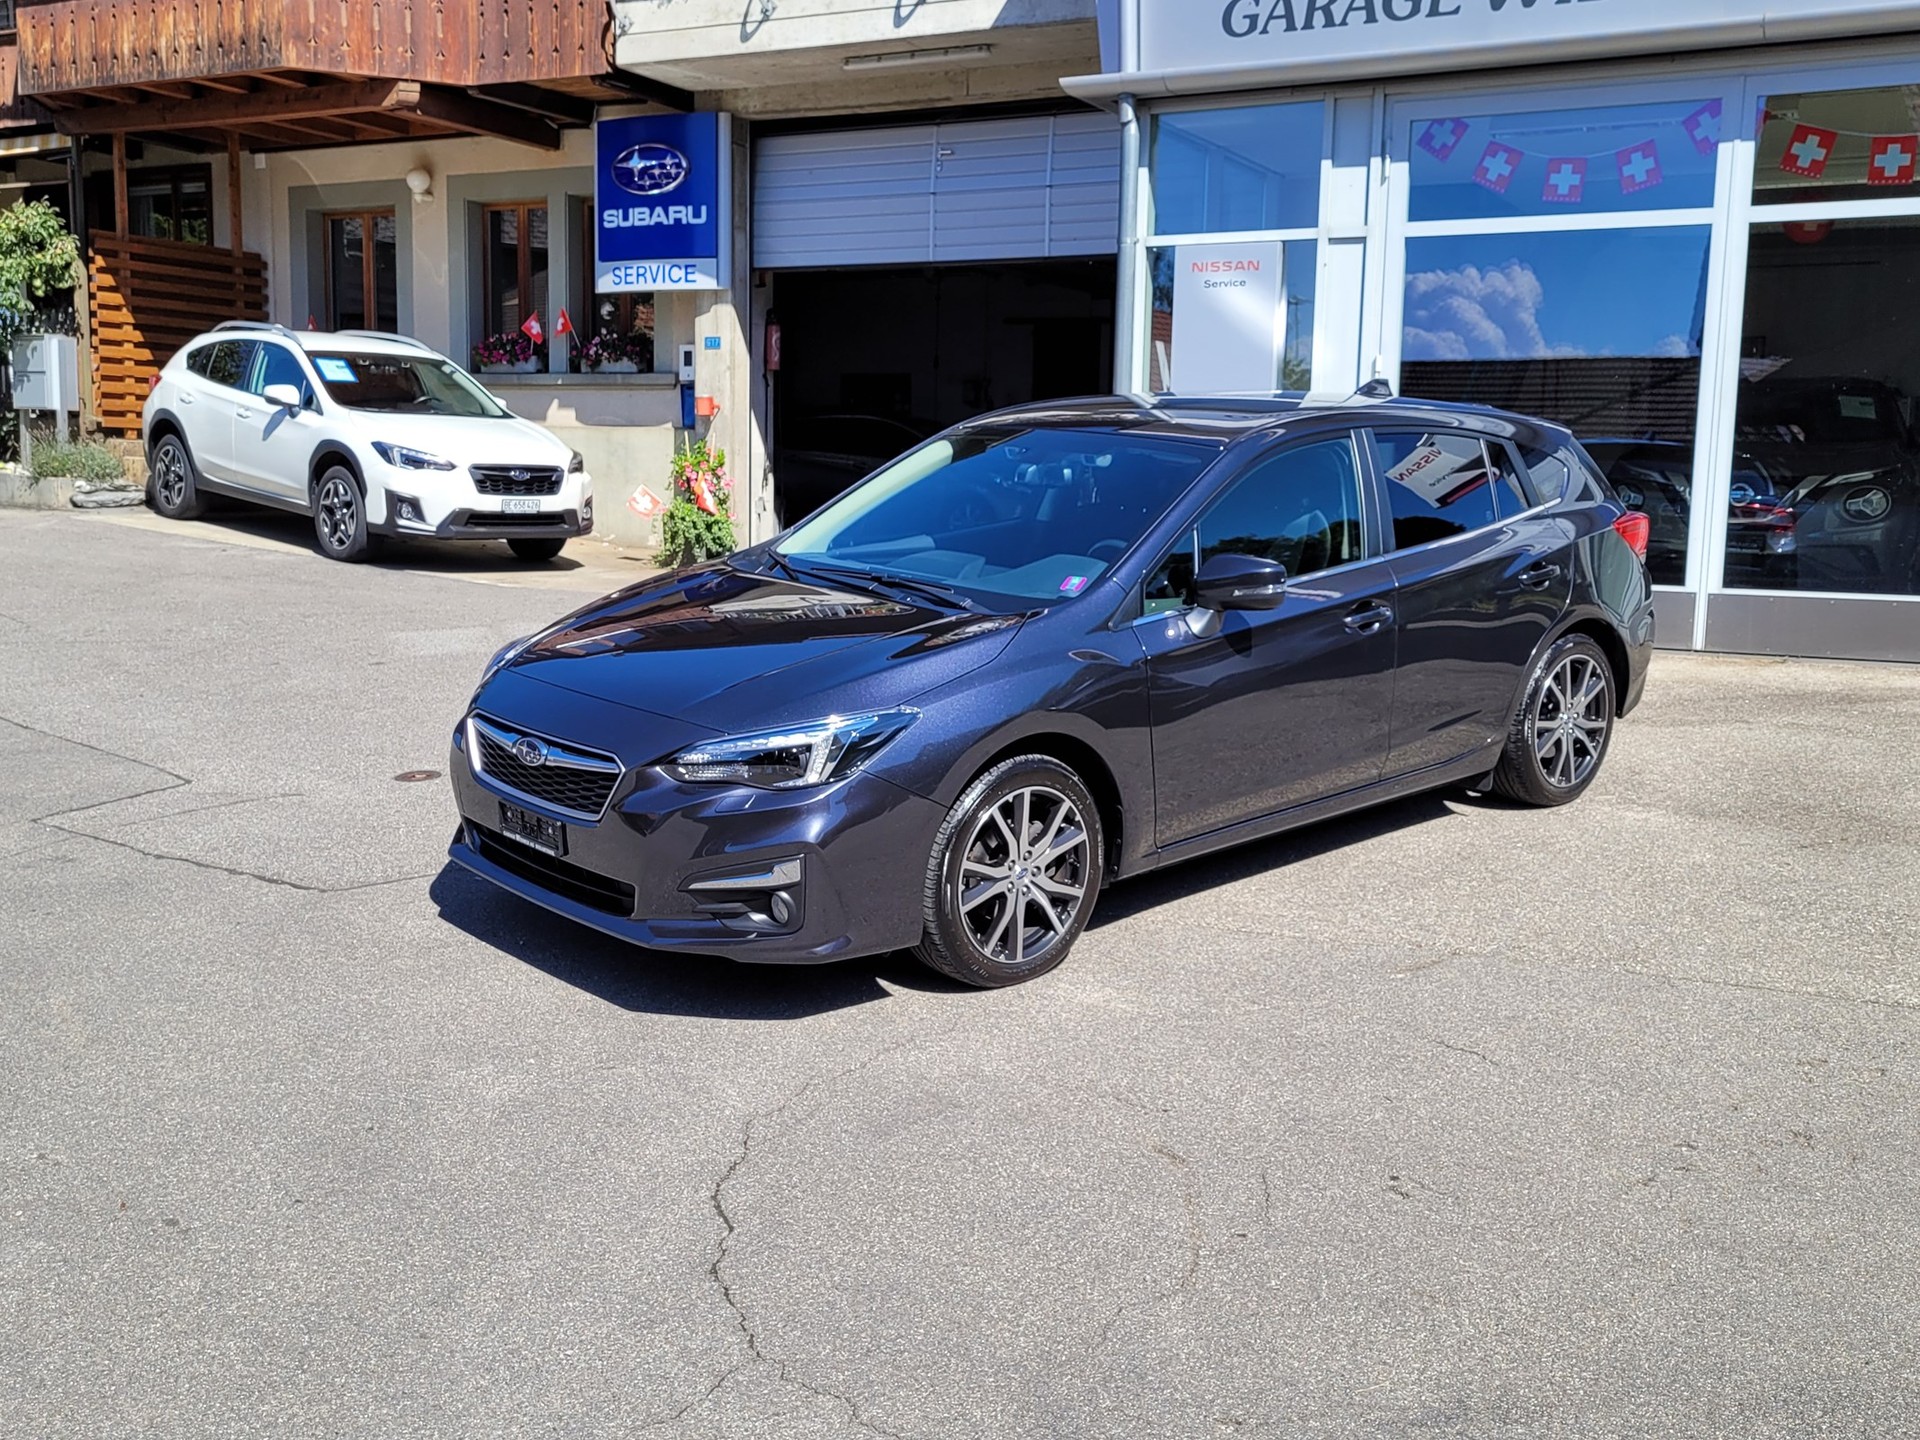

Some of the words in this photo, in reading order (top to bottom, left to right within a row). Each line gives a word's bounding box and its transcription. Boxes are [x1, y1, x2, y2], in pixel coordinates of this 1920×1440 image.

[602, 205, 707, 228] SUBARU
[611, 264, 697, 285] SERVICE
[1191, 260, 1260, 273] NISSAN
[1203, 279, 1247, 289] Service
